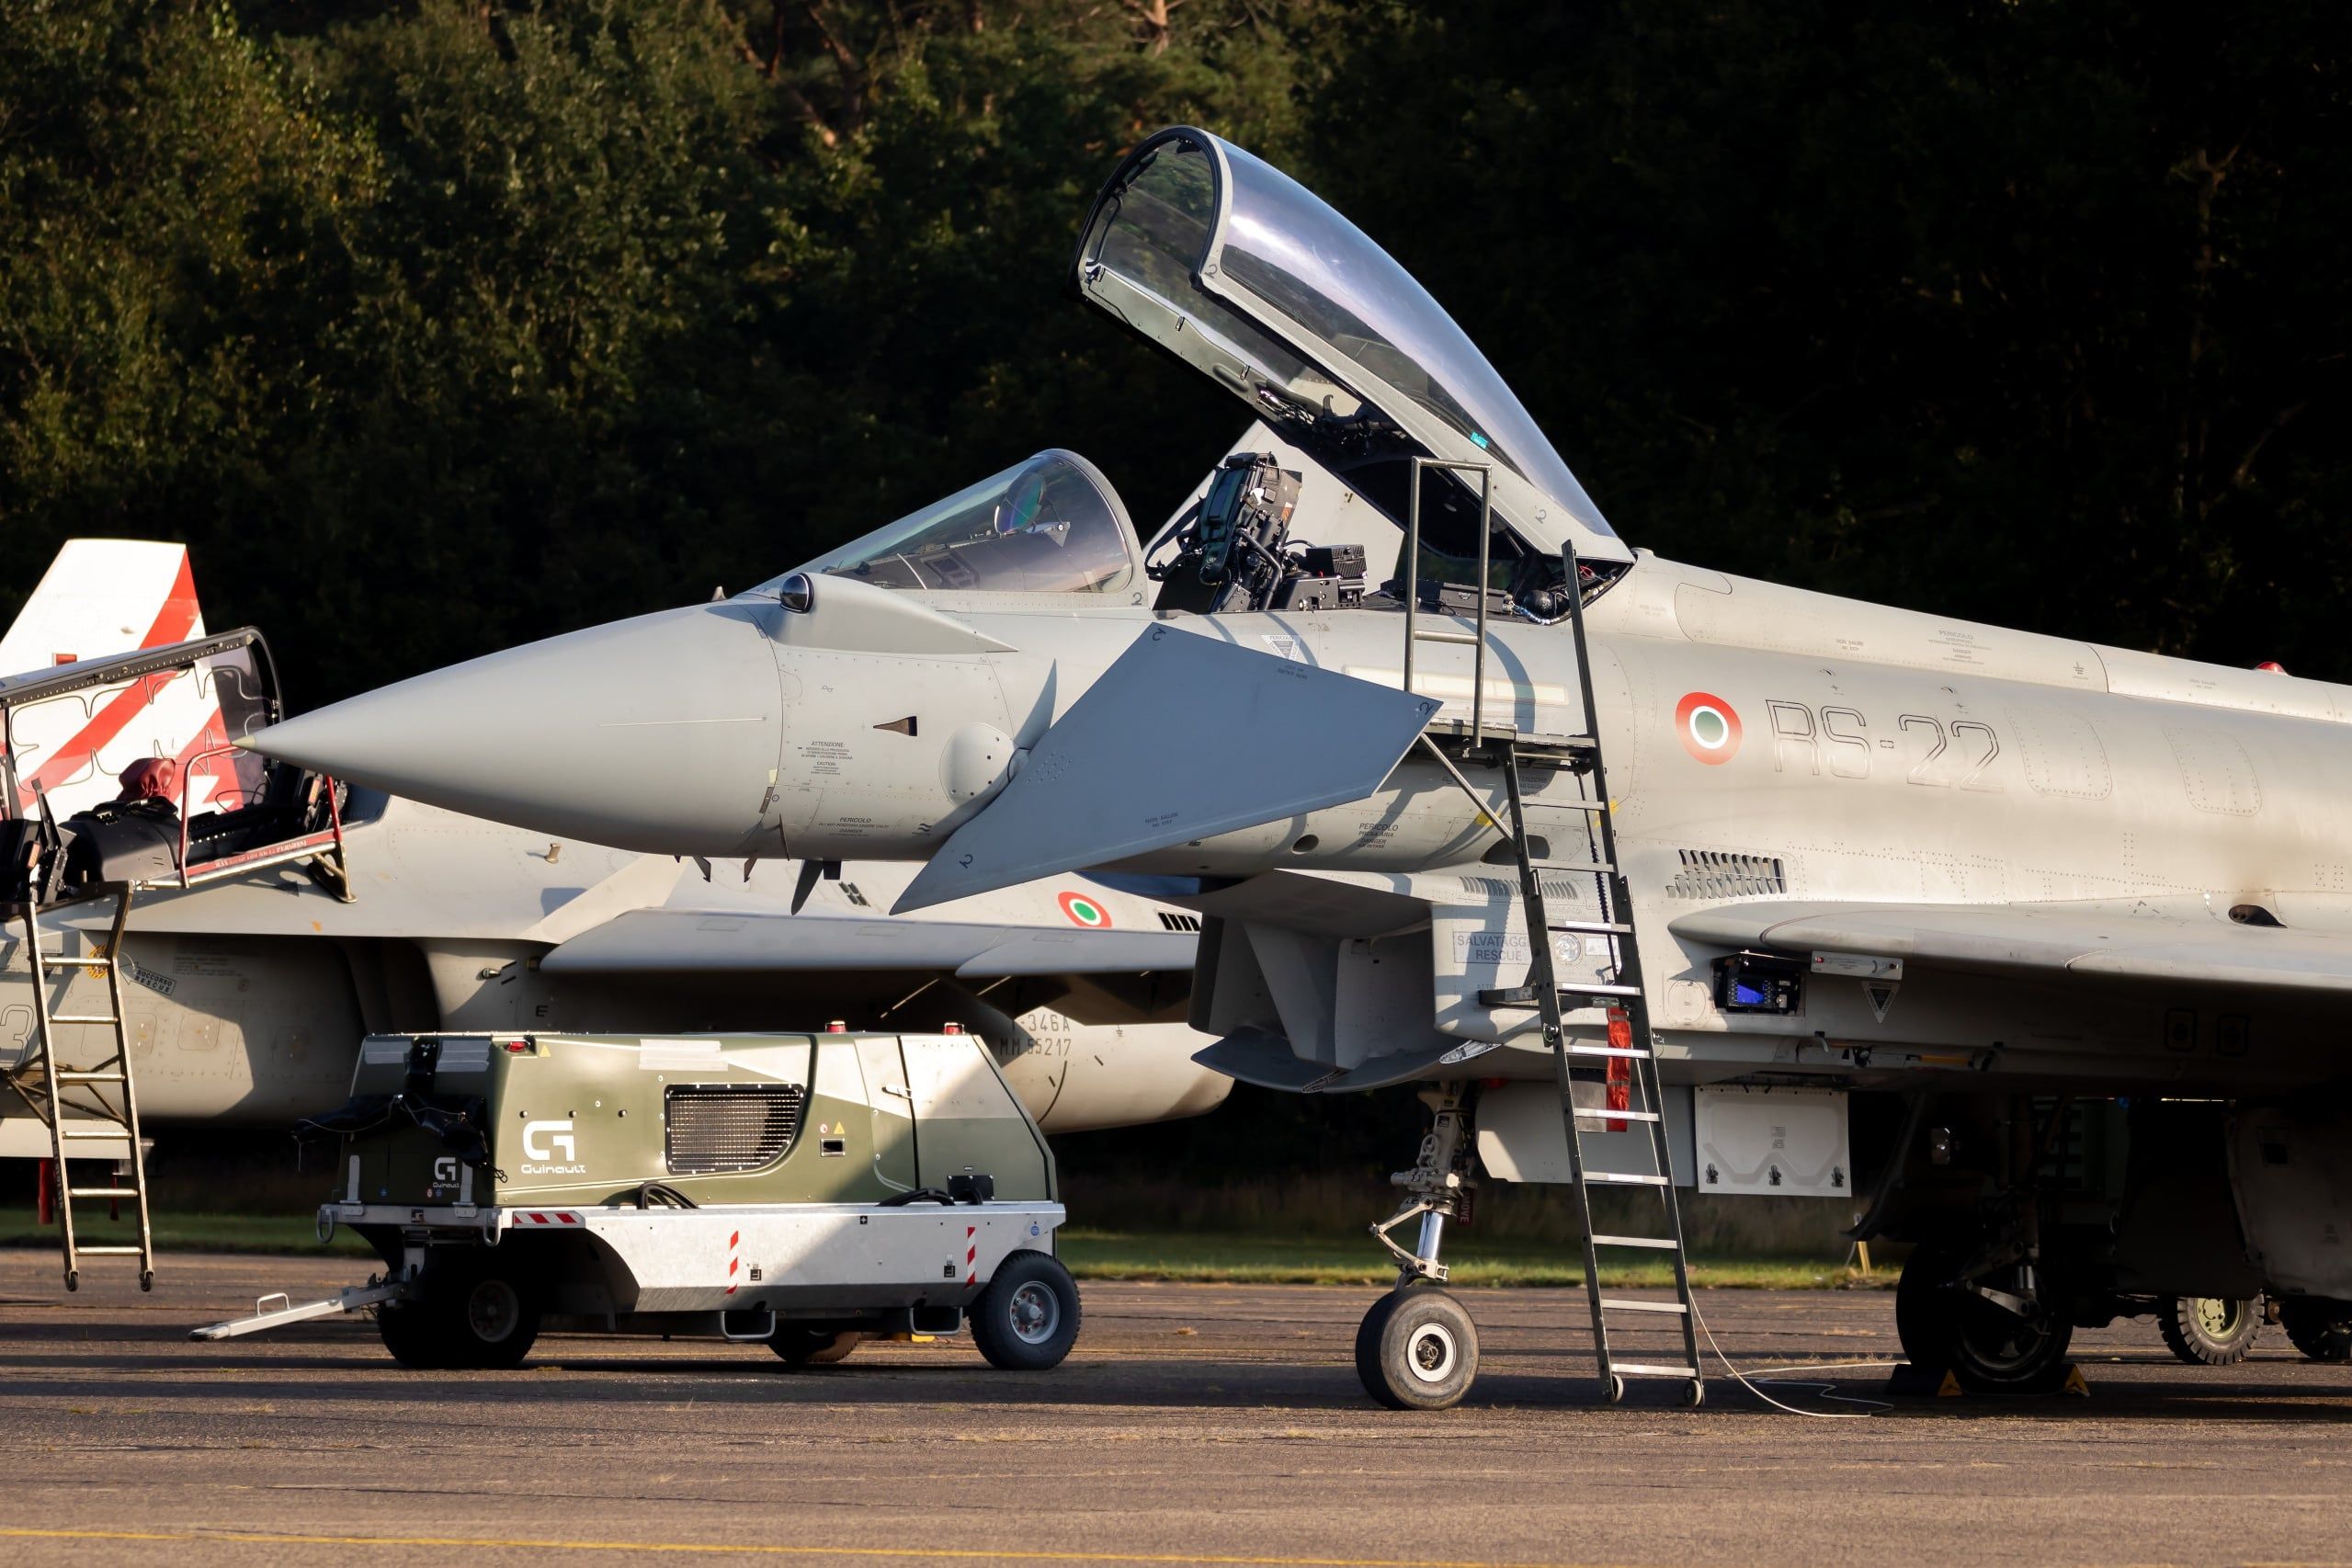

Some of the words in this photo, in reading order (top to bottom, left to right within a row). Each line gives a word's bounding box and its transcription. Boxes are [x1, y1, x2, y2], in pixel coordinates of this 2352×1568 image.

[1766, 699, 2005, 794] RS-22
[1358, 823, 1399, 832] PERICOLO
[1458, 934, 1531, 947] SALVATAGG
[1475, 950, 1522, 961] RESCUE
[133, 975, 171, 993] RESCUE
[137, 969, 173, 987] SOCCORSO
[520, 1164, 586, 1175] Guinault
